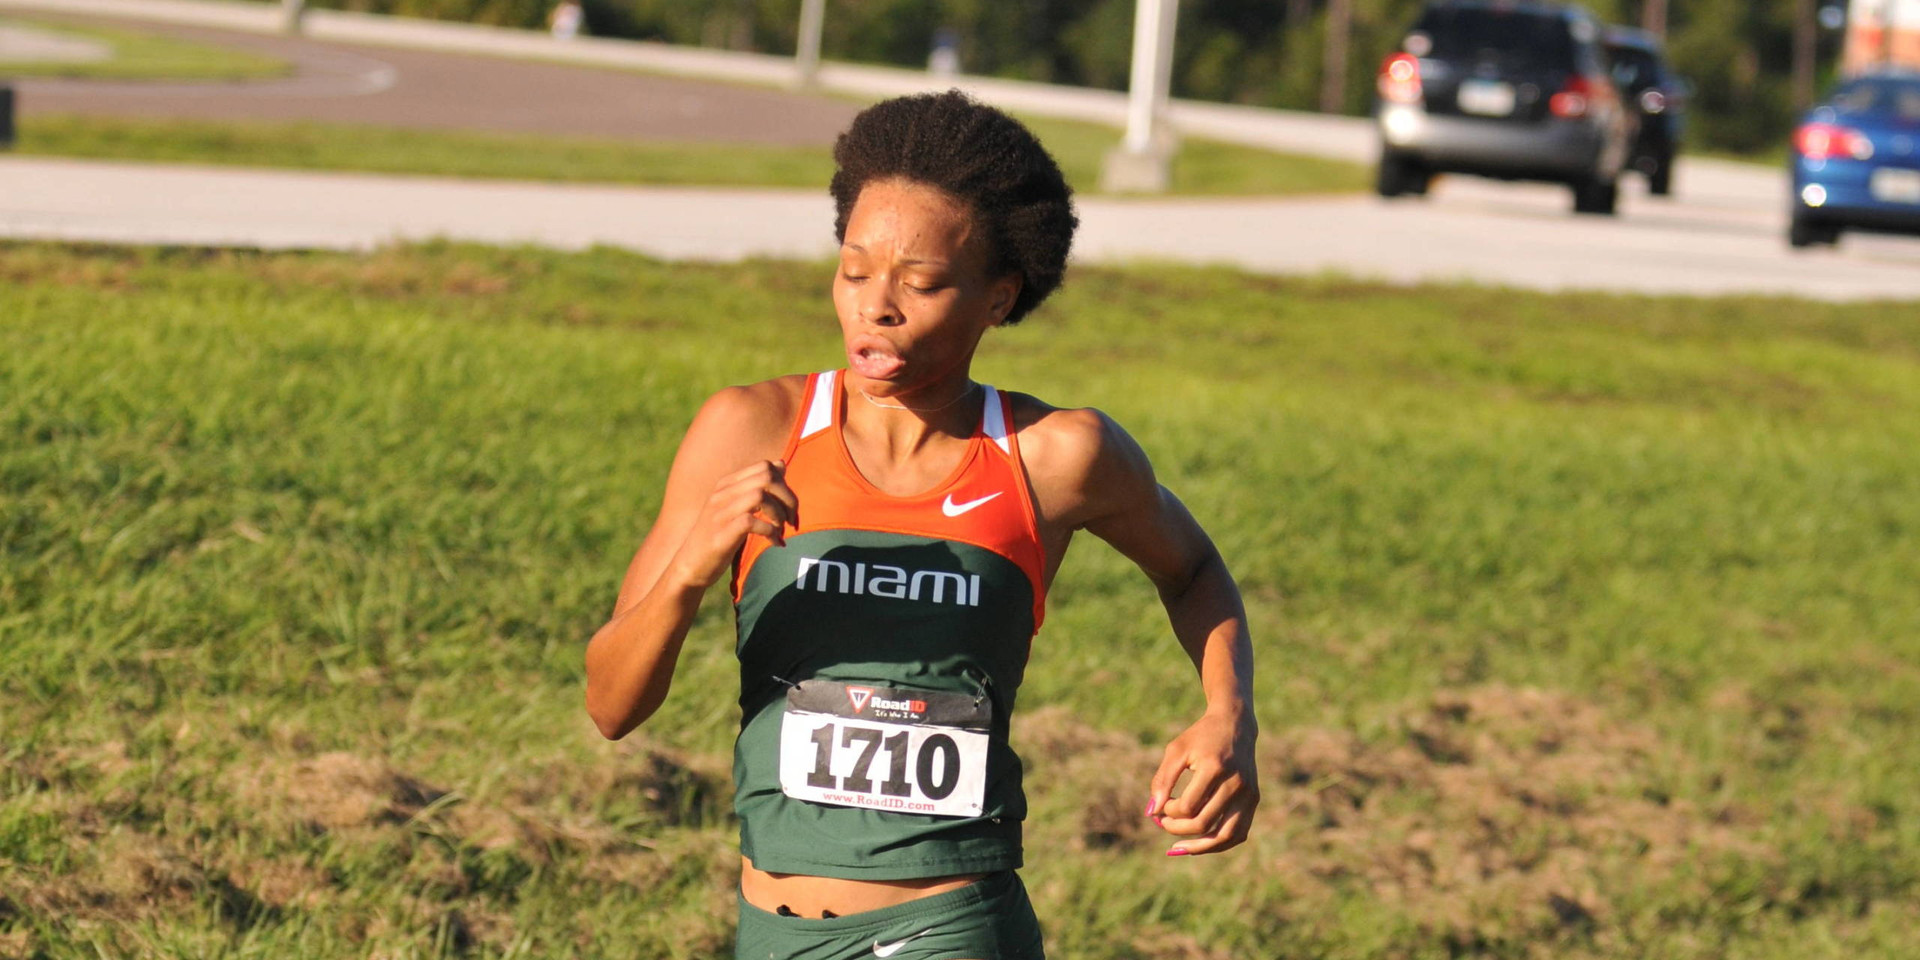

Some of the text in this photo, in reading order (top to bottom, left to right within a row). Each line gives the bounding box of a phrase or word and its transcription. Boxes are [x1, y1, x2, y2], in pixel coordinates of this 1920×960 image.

[870, 696, 927, 713] RoadID
[807, 722, 960, 801] 1710
[823, 793, 935, 811] www.RoadID.com
